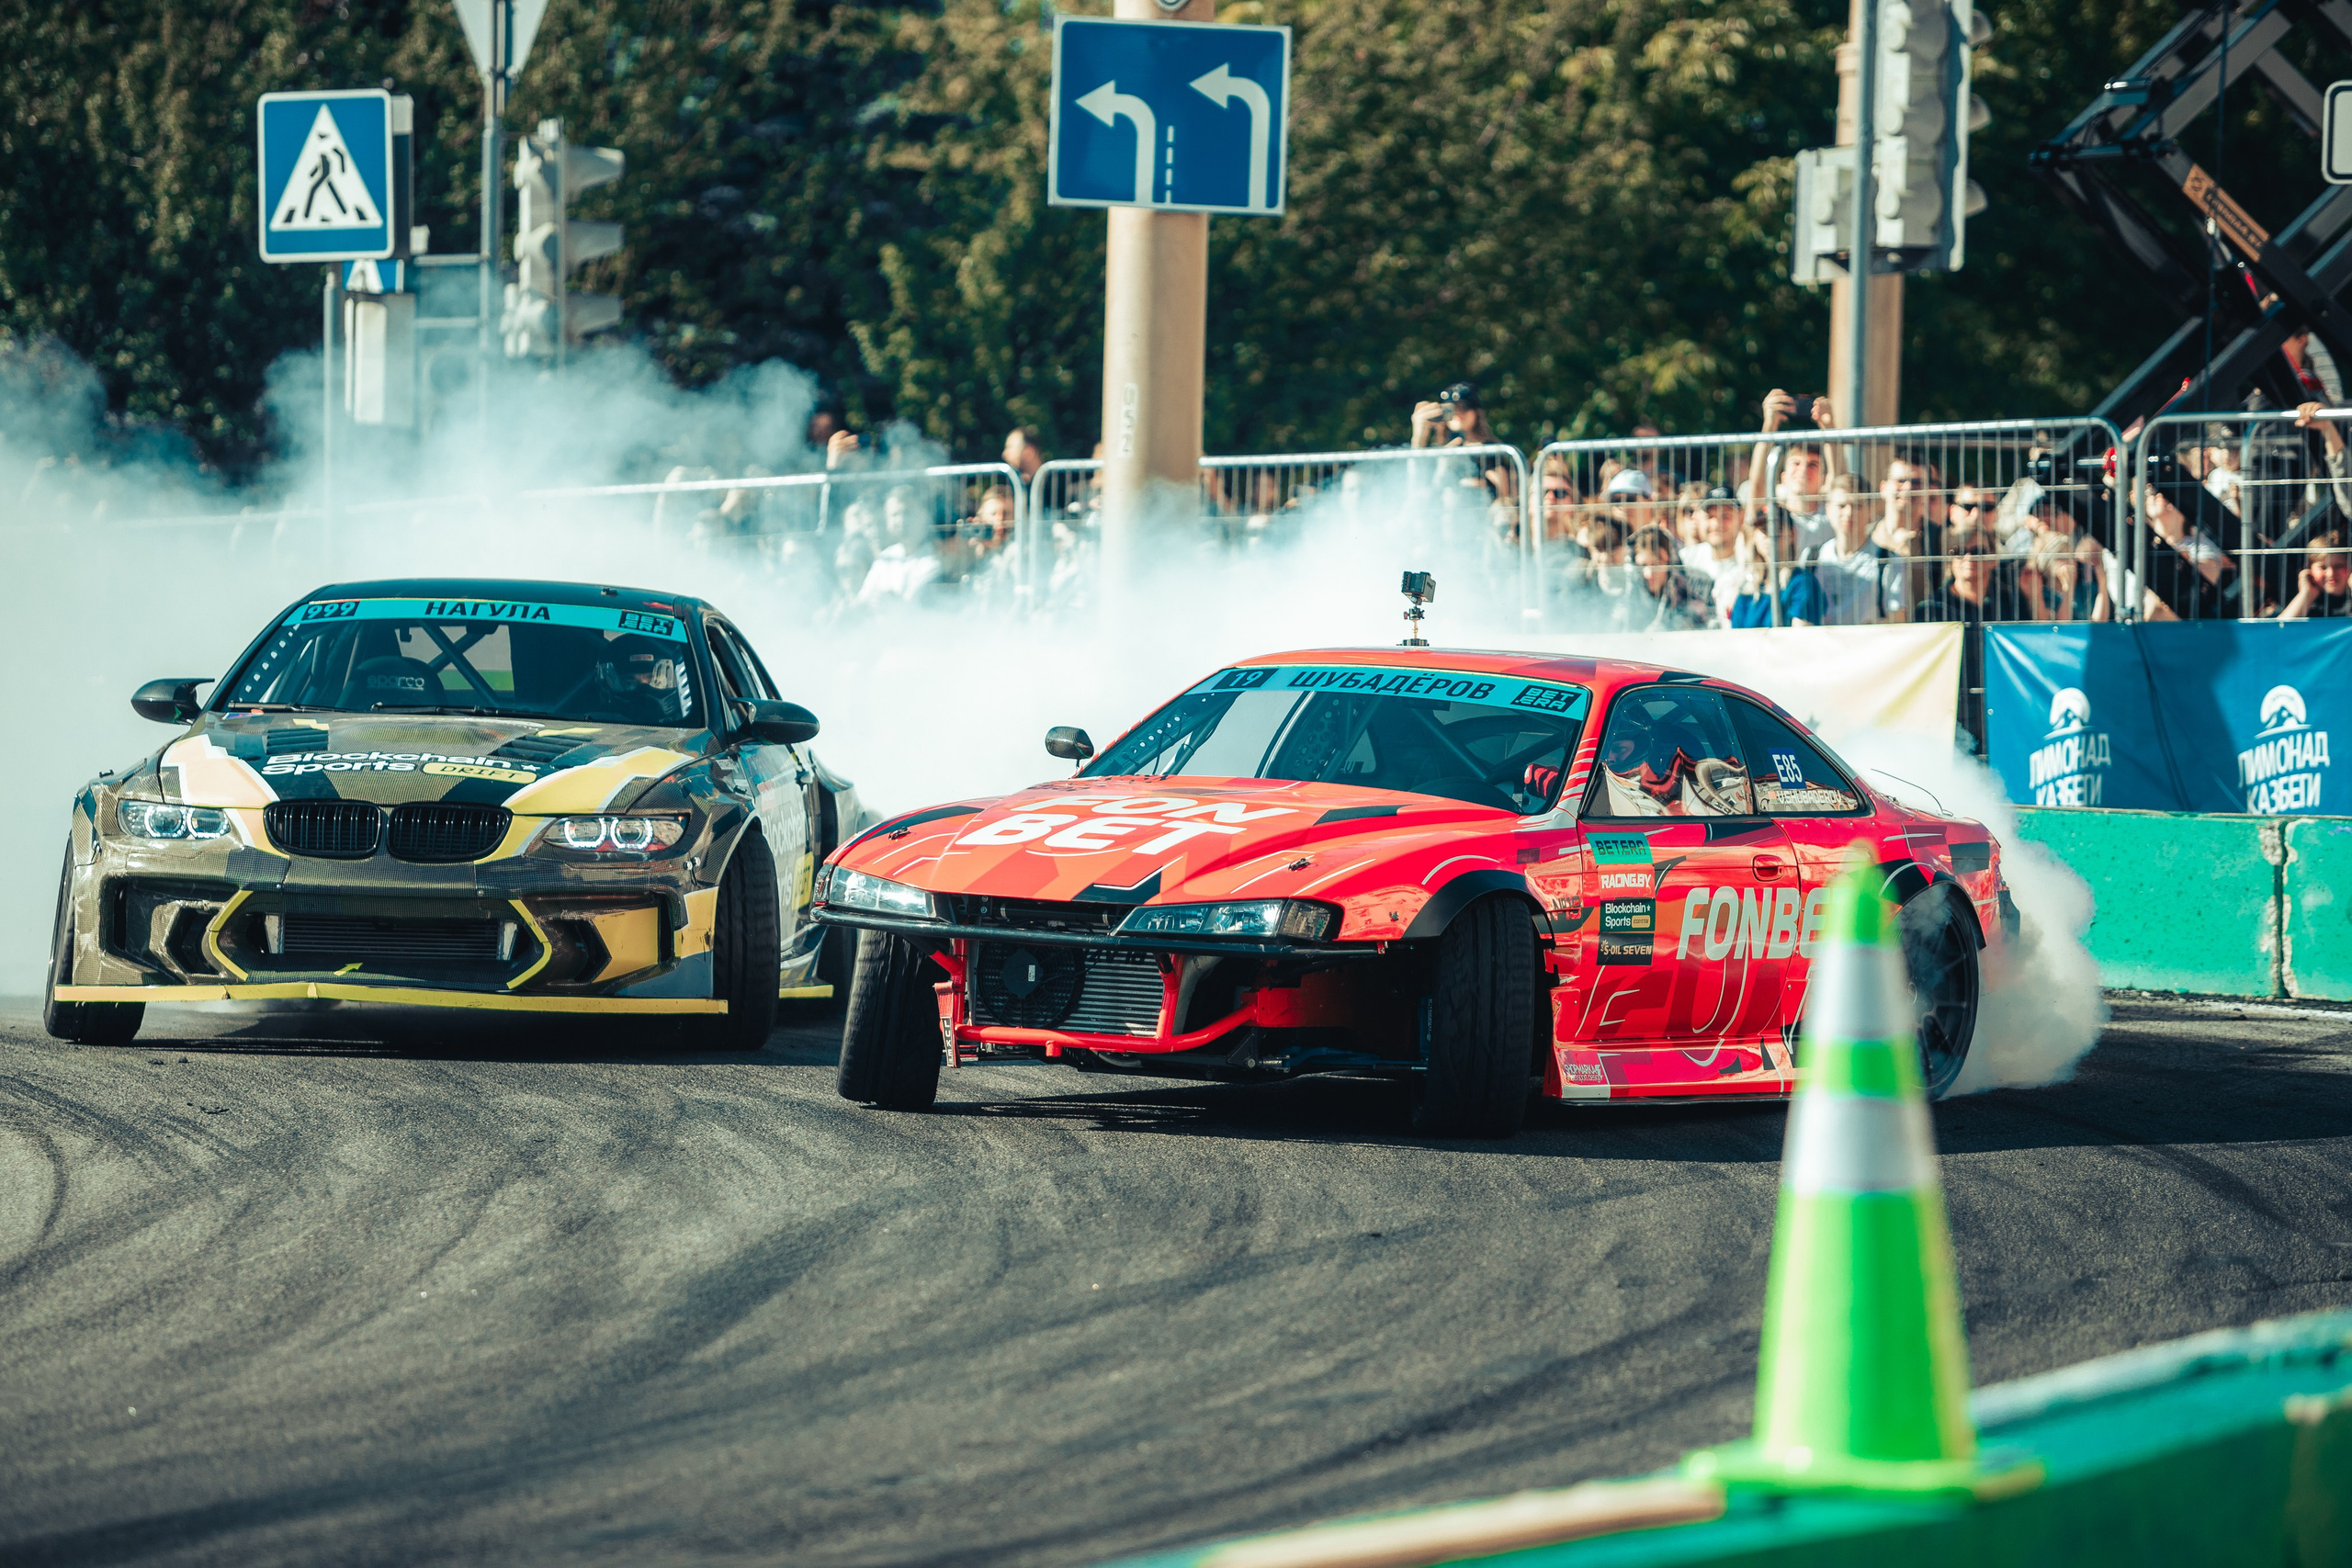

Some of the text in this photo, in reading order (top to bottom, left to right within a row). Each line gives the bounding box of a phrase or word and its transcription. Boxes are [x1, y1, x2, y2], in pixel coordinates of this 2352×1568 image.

[307, 601, 356, 619] 999
[424, 601, 551, 620] НАГУЛА
[625, 613, 672, 627] BET
[1232, 670, 1265, 687] 19
[1287, 670, 1497, 701] ШУБАДЁРОВ
[1525, 686, 1577, 702] BET
[266, 751, 513, 769] Blockchain
[1771, 754, 1803, 784] E85
[2029, 733, 2112, 790] ЛИМОНАД
[2237, 730, 2331, 789] ЛИМОНАД
[261, 761, 523, 780] Sports DRIFT
[2245, 772, 2322, 816] КАЗБЕГИ
[1010, 795, 1300, 824] FON
[955, 813, 1249, 855] BET
[1605, 902, 1646, 914] Blockchain
[1605, 916, 1632, 930] Sports
[1676, 886, 1845, 961] FONBE
[1603, 944, 1653, 955] S-OIL SEVEN
